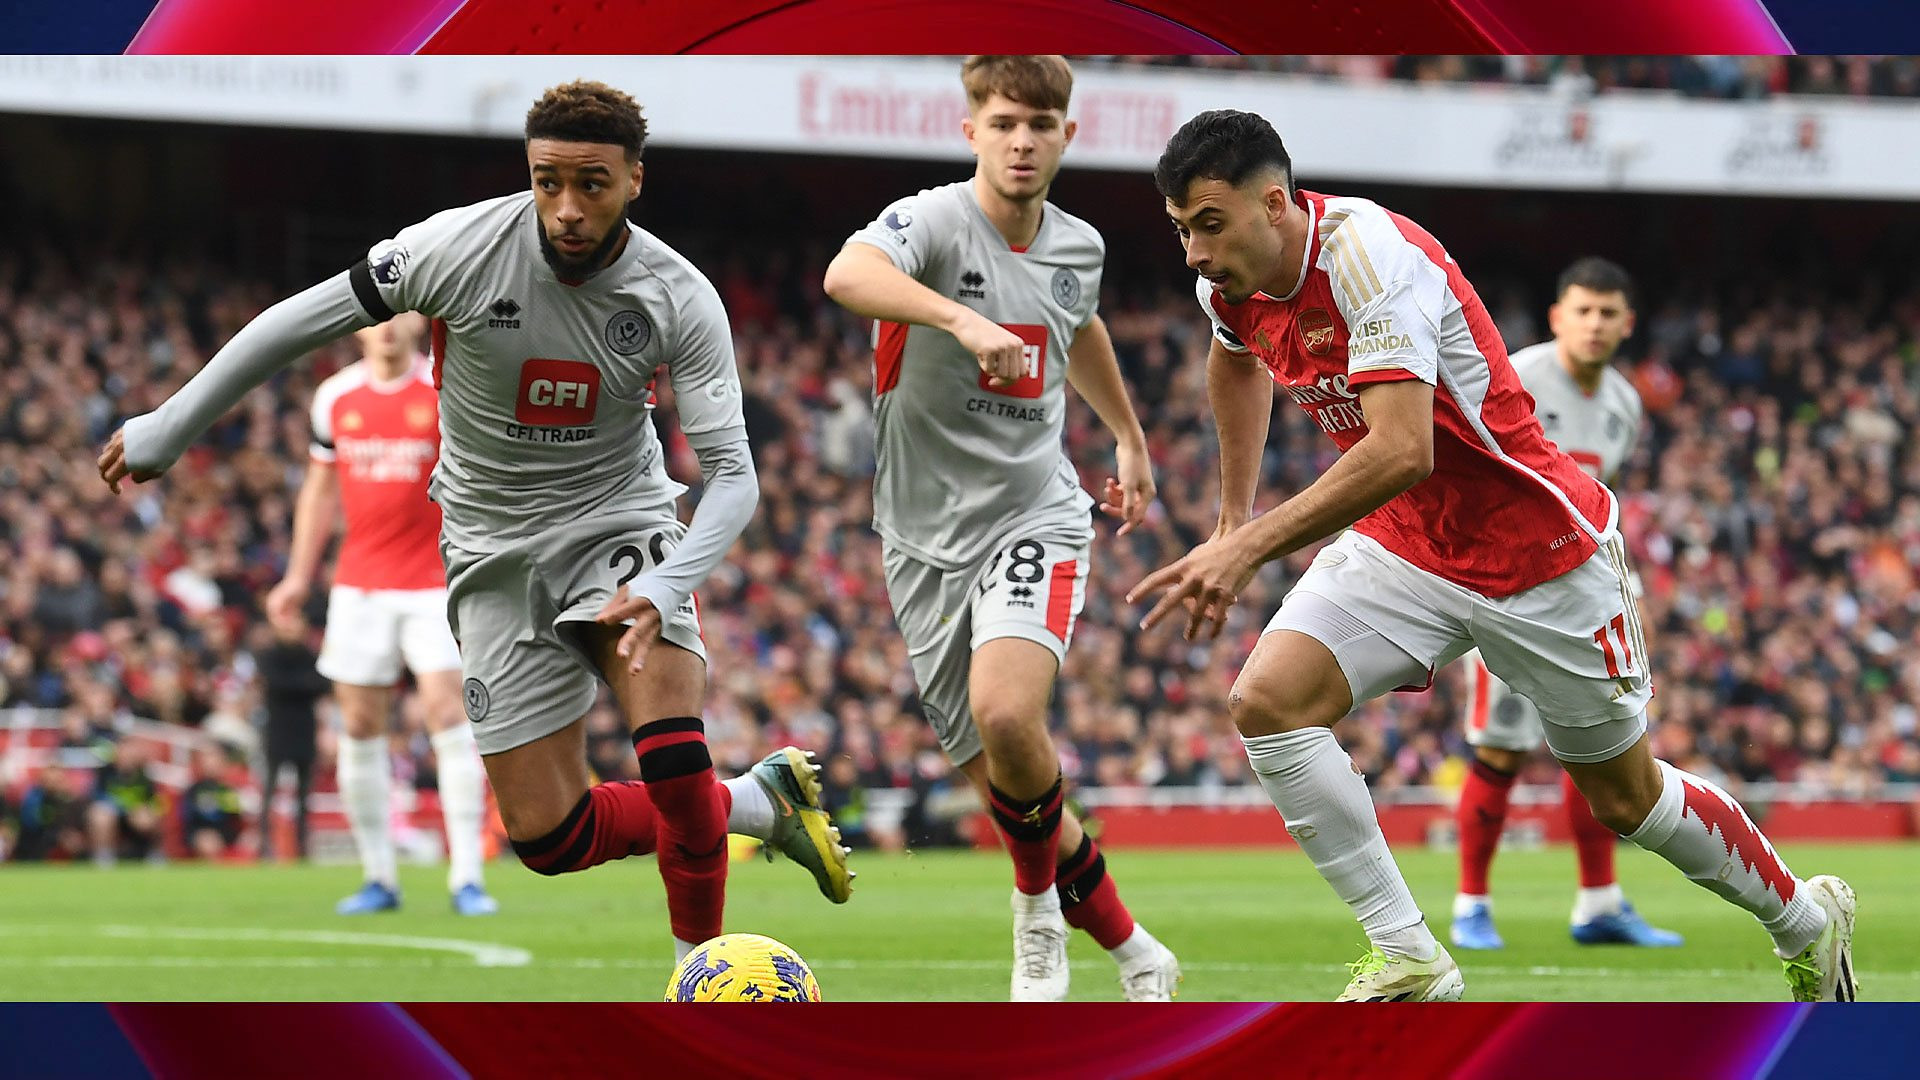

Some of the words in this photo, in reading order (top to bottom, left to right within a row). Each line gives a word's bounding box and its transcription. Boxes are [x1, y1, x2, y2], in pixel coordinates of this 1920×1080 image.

[1355, 318, 1393, 339] VISIT
[1348, 333, 1414, 357] WANDA
[528, 379, 589, 409] CFI
[966, 398, 1045, 422] CFI.TRADE
[505, 423, 598, 442] CFI.TRADE
[1593, 612, 1634, 680] 11
